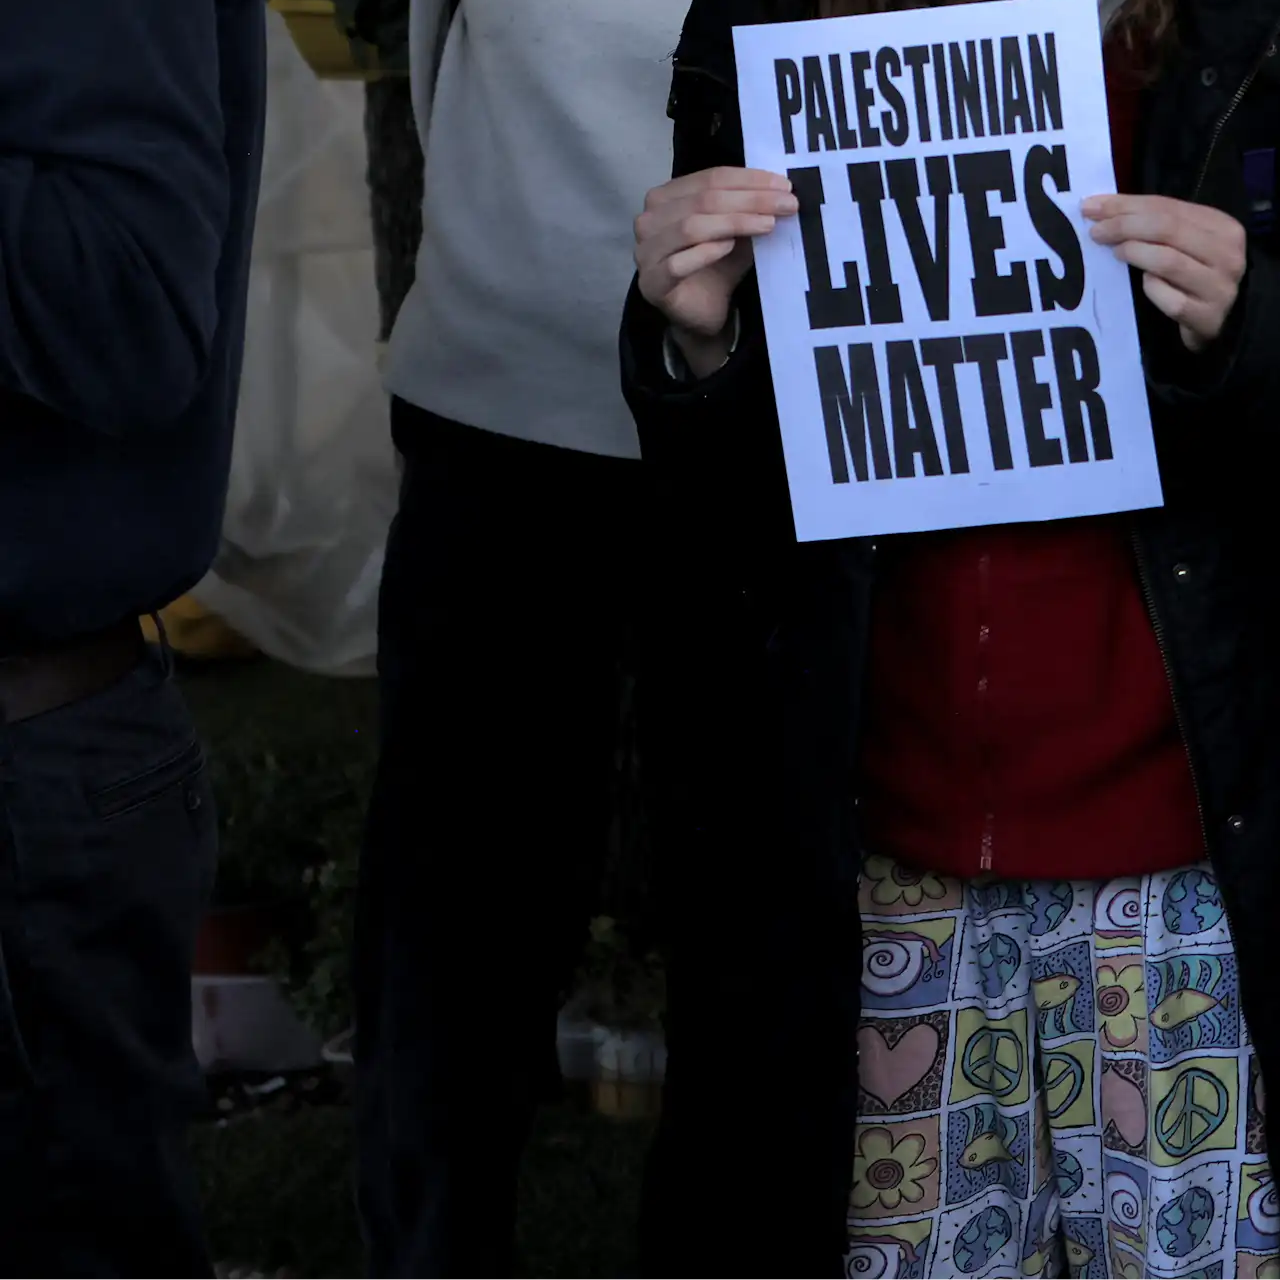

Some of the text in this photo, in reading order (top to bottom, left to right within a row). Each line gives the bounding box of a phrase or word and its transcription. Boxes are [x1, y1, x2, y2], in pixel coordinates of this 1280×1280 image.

[774, 32, 1064, 155] PALESTINIAN
[787, 143, 1086, 330] LIVES
[813, 325, 1114, 485] MATTER
